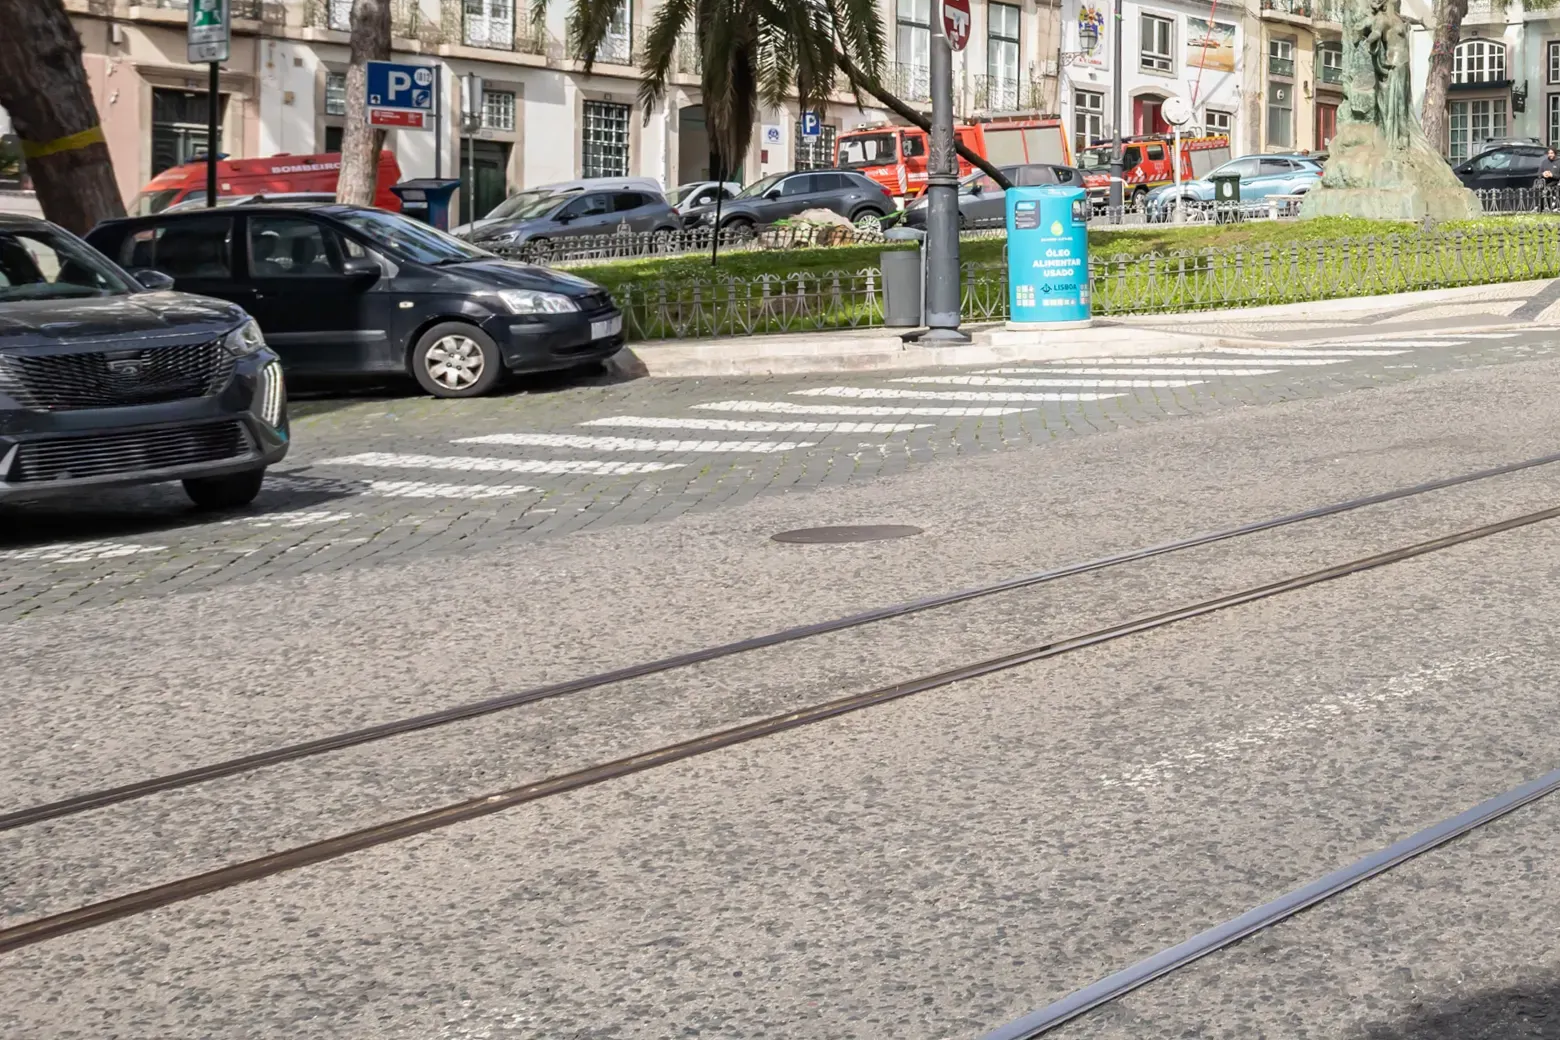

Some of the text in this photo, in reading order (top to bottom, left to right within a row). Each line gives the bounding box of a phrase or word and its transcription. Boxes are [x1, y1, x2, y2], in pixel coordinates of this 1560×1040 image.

[388, 70, 411, 101] P
[805, 114, 817, 133] P
[1045, 248, 1071, 258] ÓLEO
[1032, 259, 1082, 268] ALIMENTAR
[1043, 269, 1074, 278] USADO
[1053, 283, 1077, 292] LISBOA
